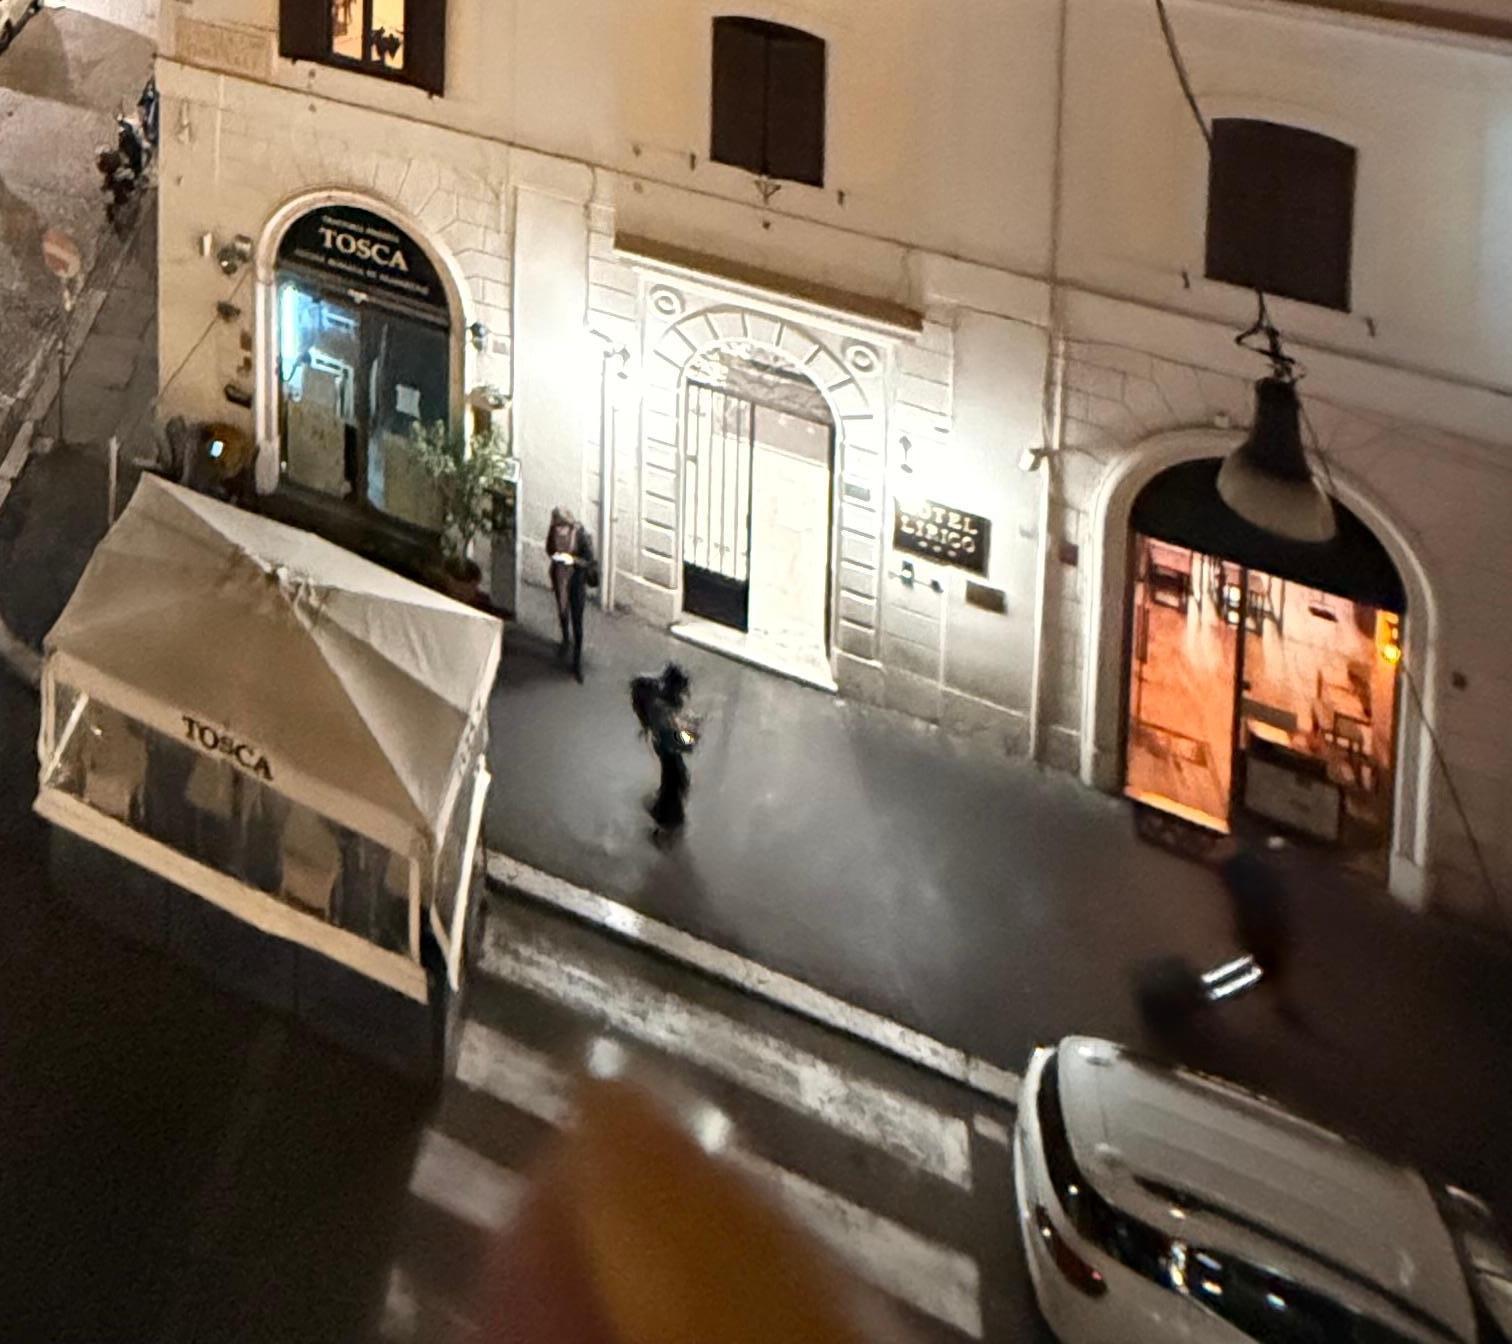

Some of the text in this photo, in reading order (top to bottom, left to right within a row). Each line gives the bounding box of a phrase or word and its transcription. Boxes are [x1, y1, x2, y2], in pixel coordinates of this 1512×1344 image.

[318, 226, 408, 272] TOSCA
[899, 500, 978, 535] OTEL
[182, 714, 273, 781] TOSCA
